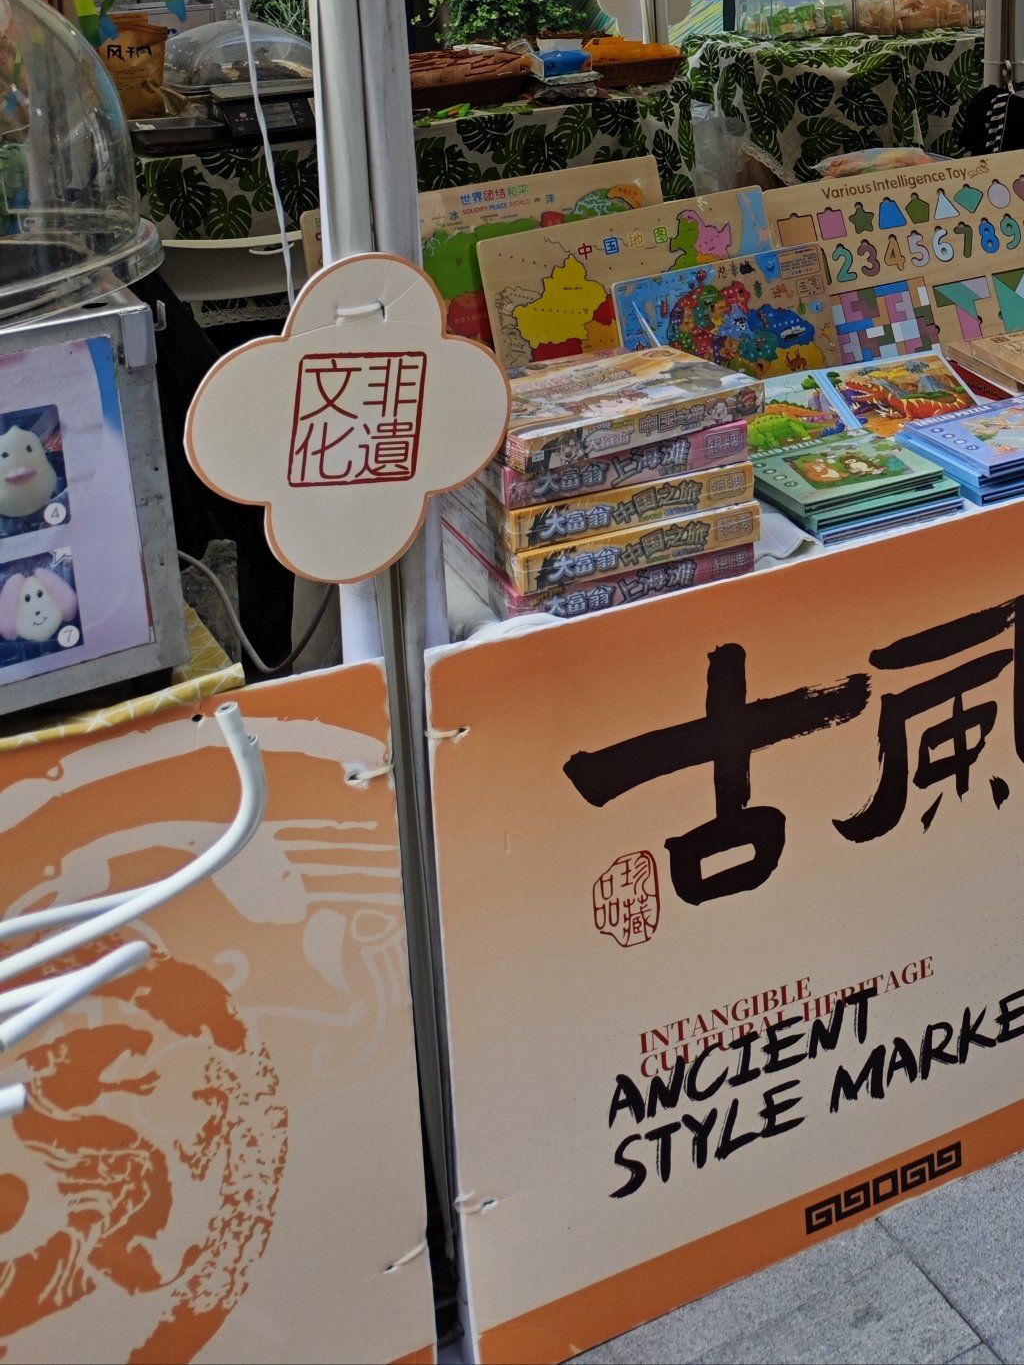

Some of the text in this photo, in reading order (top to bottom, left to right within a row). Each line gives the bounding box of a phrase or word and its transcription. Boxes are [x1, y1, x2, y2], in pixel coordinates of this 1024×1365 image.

[460, 185, 529, 206] 世界团结和平
[820, 181, 873, 201] Various
[873, 171, 947, 193] Intelligence
[944, 167, 967, 184] Toy
[578, 226, 669, 261] 中国地图
[831, 244, 858, 283] 2
[857, 240, 881, 277] 3
[884, 235, 906, 271] 4
[907, 231, 930, 267] 5
[932, 227, 954, 262] 6
[954, 222, 973, 258] 7
[978, 218, 1000, 254] 8
[1001, 213, 1022, 250] 9
[536, 463, 609, 495] 大富翁
[610, 437, 692, 486] 上海滩
[540, 504, 613, 540] 大富翁
[612, 480, 703, 524] 中国之旅
[549, 547, 621, 582] 大富翁
[621, 521, 711, 567] 中国之旅
[547, 586, 616, 618] 大富翁
[618, 558, 698, 603] 上海滩
[640, 976, 812, 1055] INTANGIBLE
[608, 986, 878, 1129] ANCIENT
[608, 1079, 810, 1199] STYLE
